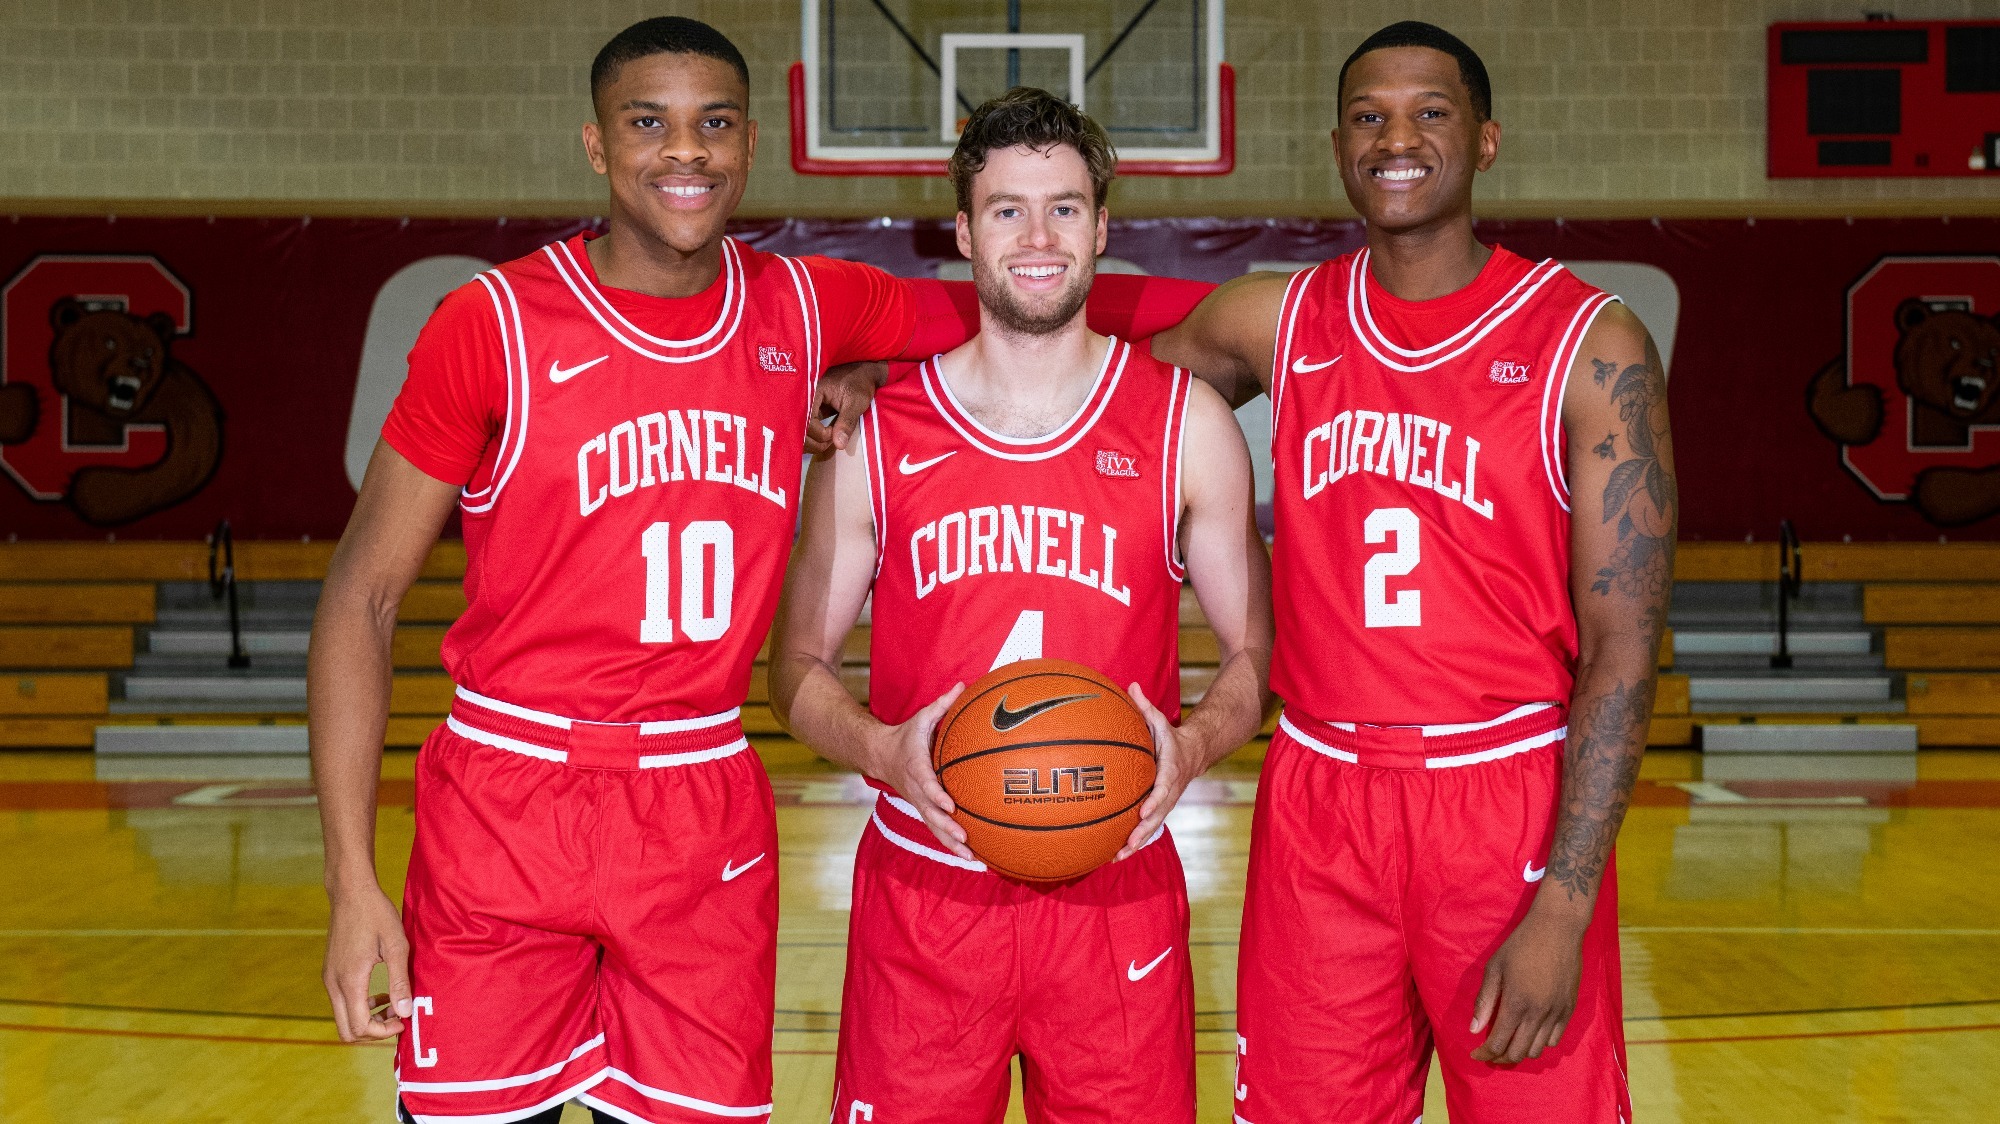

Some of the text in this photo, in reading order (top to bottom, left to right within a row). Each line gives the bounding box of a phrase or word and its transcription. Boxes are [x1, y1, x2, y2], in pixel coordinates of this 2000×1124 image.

[767, 352, 792, 365] IVY
[1501, 365, 1530, 377] IVY
[578, 409, 786, 516] CORNELL
[1105, 468, 1137, 477] LEAGUE
[1106, 456, 1136, 470] IVY
[1303, 410, 1494, 520] CORNELL
[911, 505, 1131, 606] CORNELL
[1364, 508, 1422, 628] 2
[640, 521, 735, 643] 10
[1003, 765, 1105, 795] ELITE
[1003, 793, 1106, 805] CHAMPIONSHIP
[411, 996, 439, 1068] C
